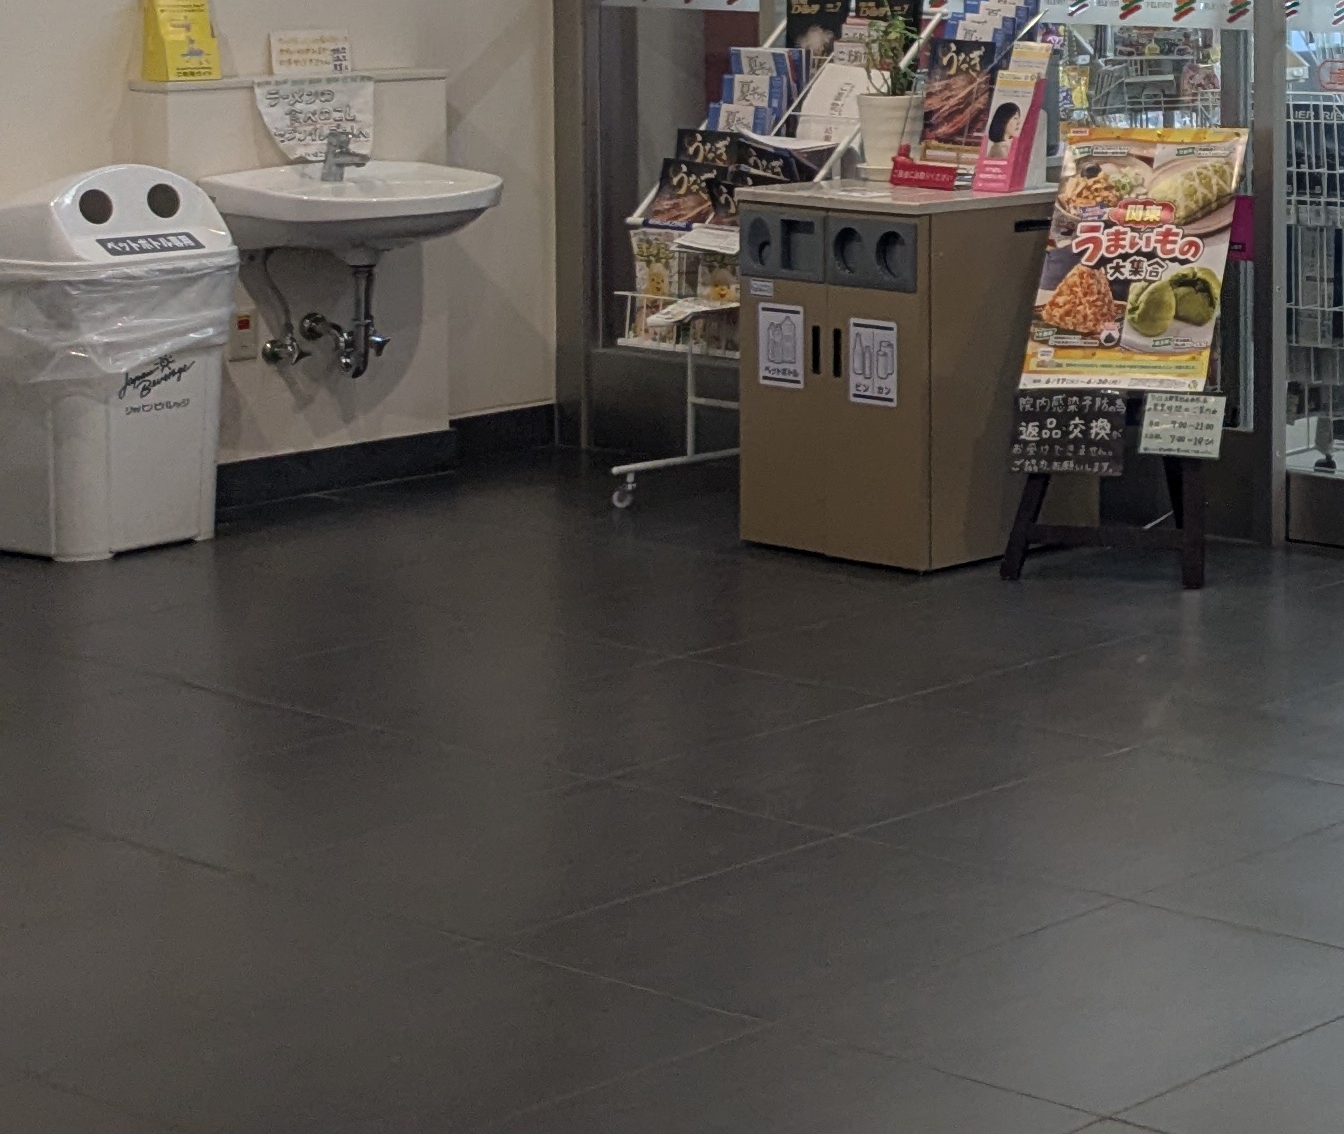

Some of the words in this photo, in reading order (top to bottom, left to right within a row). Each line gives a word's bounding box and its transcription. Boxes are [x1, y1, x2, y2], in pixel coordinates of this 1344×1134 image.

[1124, 203, 1164, 224] 関東
[1072, 222, 1206, 266] うまいもの
[1106, 256, 1167, 282] 大集合
[855, 382, 870, 394] ビン
